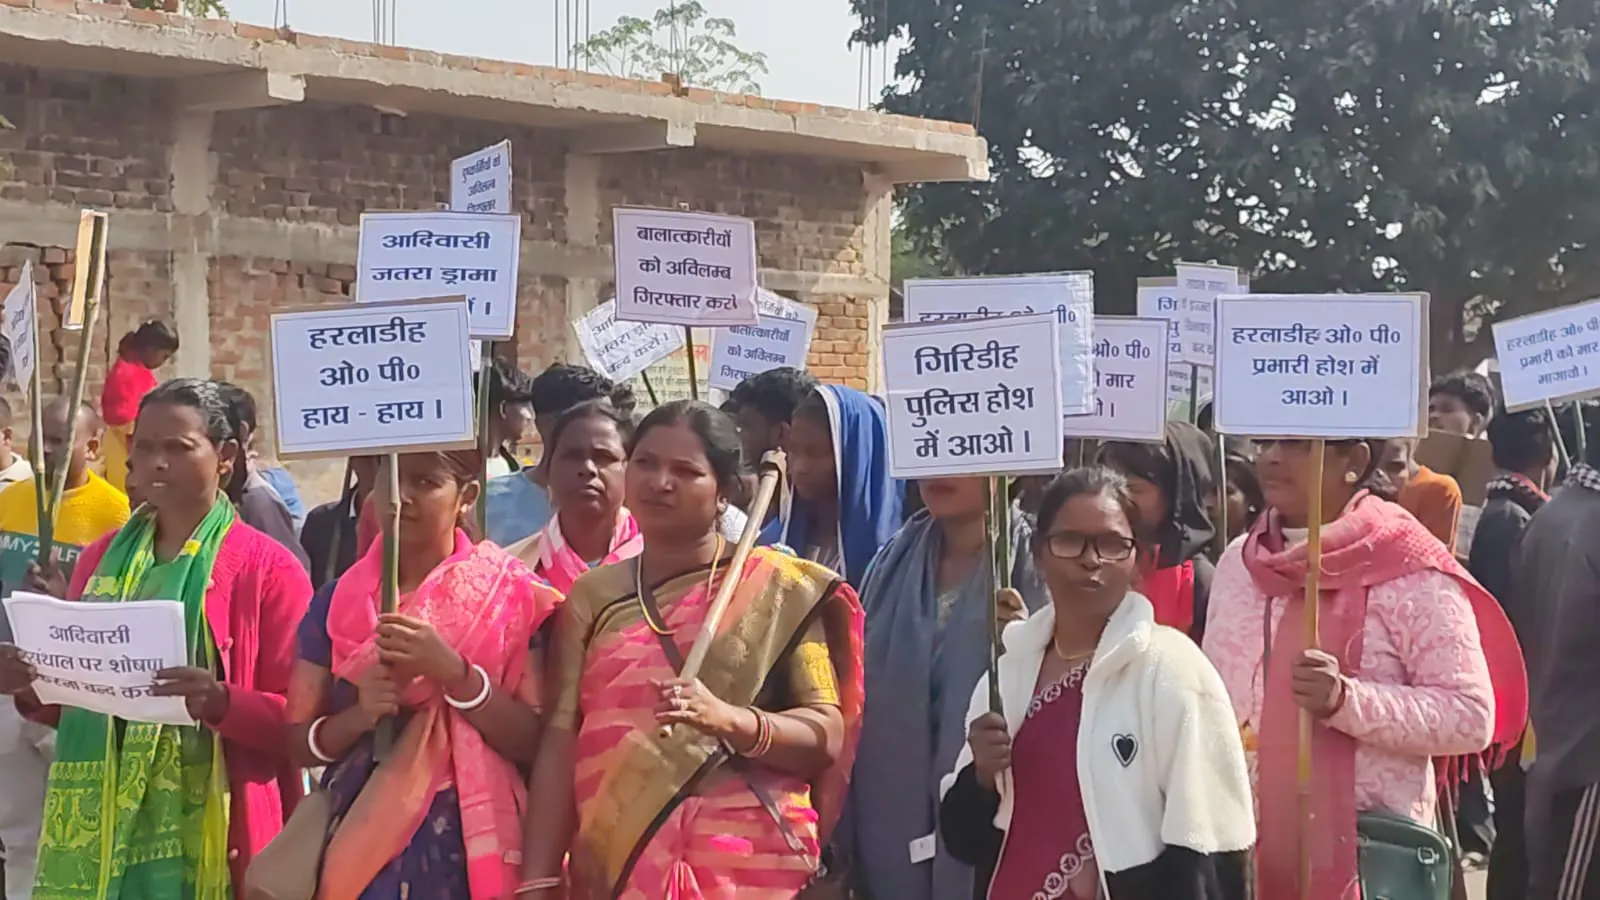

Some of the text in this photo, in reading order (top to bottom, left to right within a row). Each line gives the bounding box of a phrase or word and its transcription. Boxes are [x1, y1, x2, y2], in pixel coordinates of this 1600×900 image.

[382, 230, 490, 249] आदिवासी
[636, 226, 732, 248] बालात्कारीयों
[371, 266, 497, 286] जतरा ड्रामा
[638, 255, 732, 280] को अविलम्ब
[633, 286, 702, 309] गिरफ्तार
[307, 316, 427, 350] हरलाडीह
[1232, 323, 1320, 345] हरलाडीह
[1326, 323, 1363, 344] ओ०
[1369, 323, 1401, 345] पी०
[1506, 328, 1557, 351] हरलाडीह
[727, 343, 741, 358] को
[744, 347, 786, 365] अविलम्ब
[914, 339, 1021, 376] गिरिडीह
[1125, 339, 1151, 360] पी०
[1556, 344, 1574, 359] को
[319, 355, 420, 387] ओ० पी०
[1252, 354, 1381, 376] प्रभारी होश में
[1105, 372, 1136, 389] मार
[904, 383, 1036, 428] पुलिस होश
[1281, 386, 1334, 406] आओ
[301, 404, 349, 429] हाय
[376, 400, 424, 424] हाय
[913, 429, 940, 459] में
[947, 425, 1014, 457] आओ
[49, 624, 131, 645] आदिवासी
[78, 656, 104, 672] पर
[109, 653, 164, 674] शोषण
